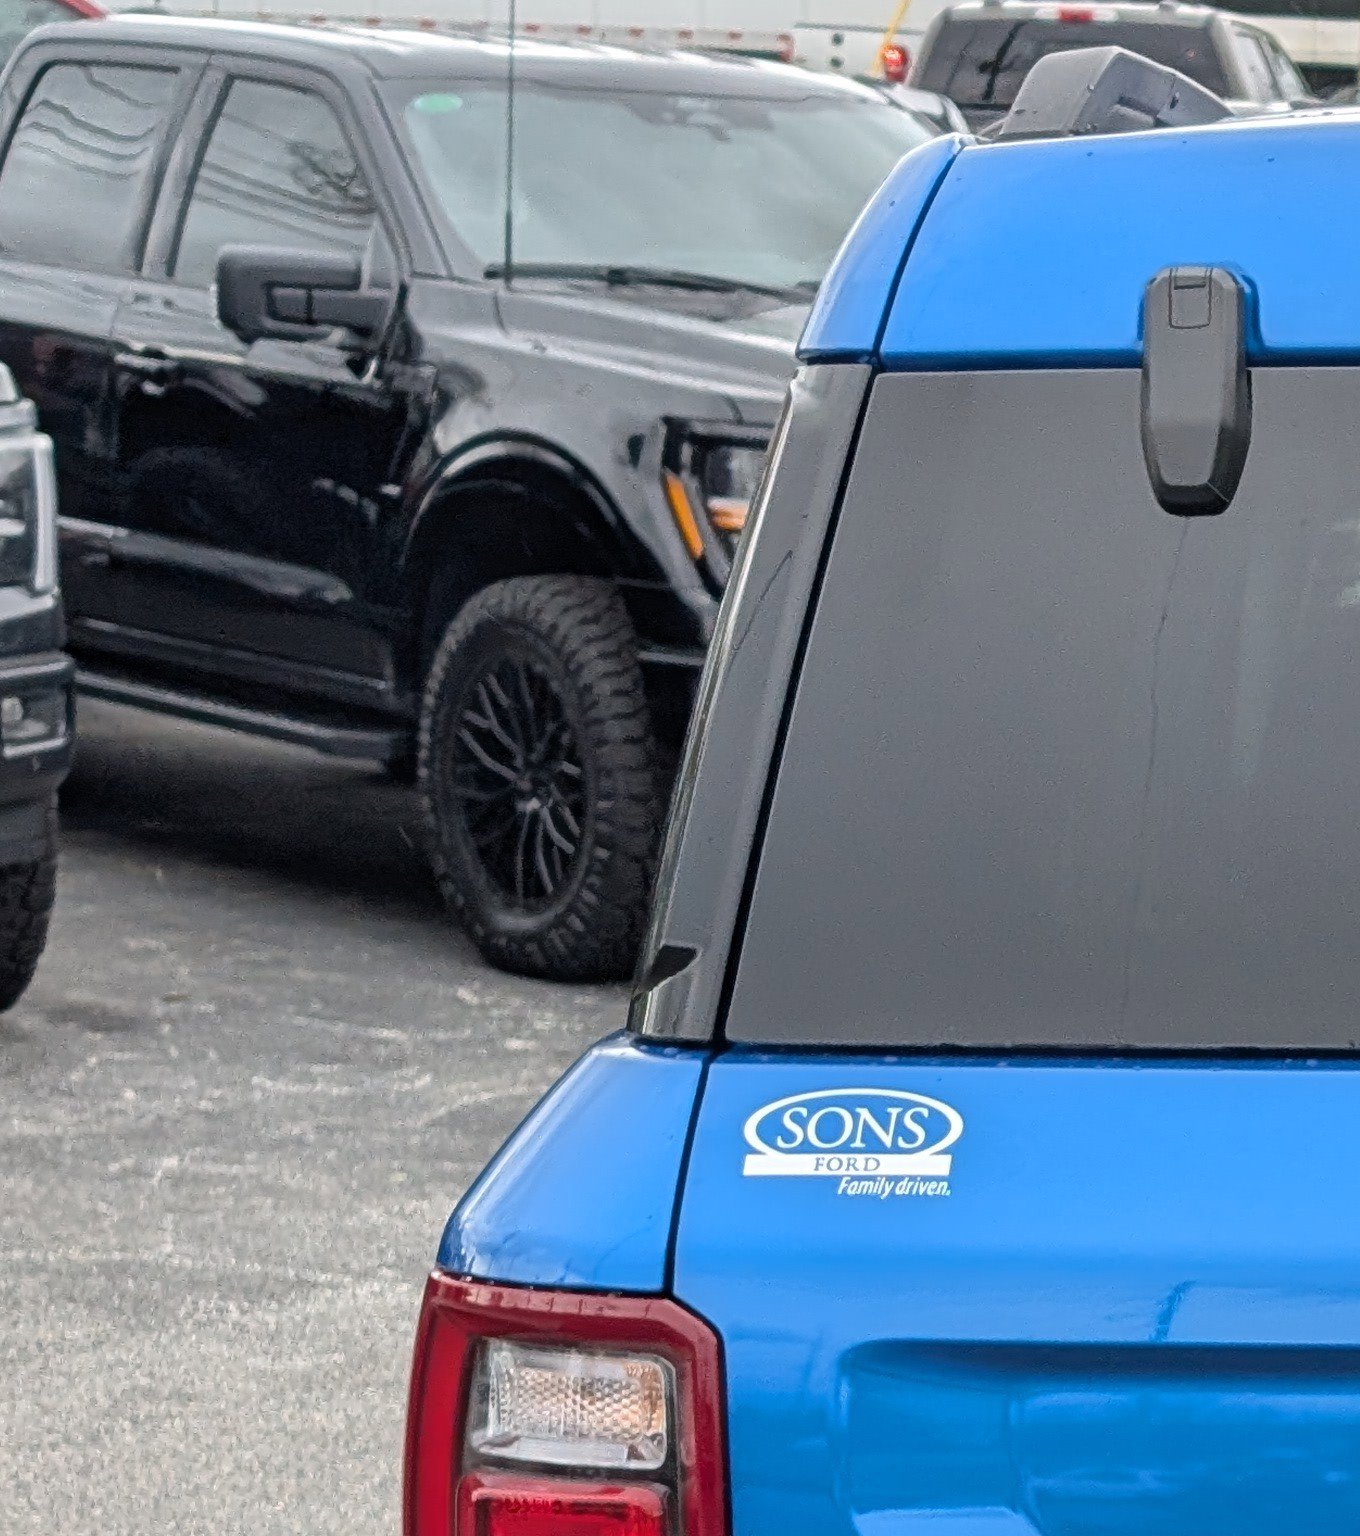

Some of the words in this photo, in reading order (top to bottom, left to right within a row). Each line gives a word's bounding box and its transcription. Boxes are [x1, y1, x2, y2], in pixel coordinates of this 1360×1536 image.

[776, 1106, 929, 1149] SONS
[813, 1156, 881, 1172] FORD
[838, 1176, 895, 1200] Family
[896, 1177, 951, 1196] driven.
